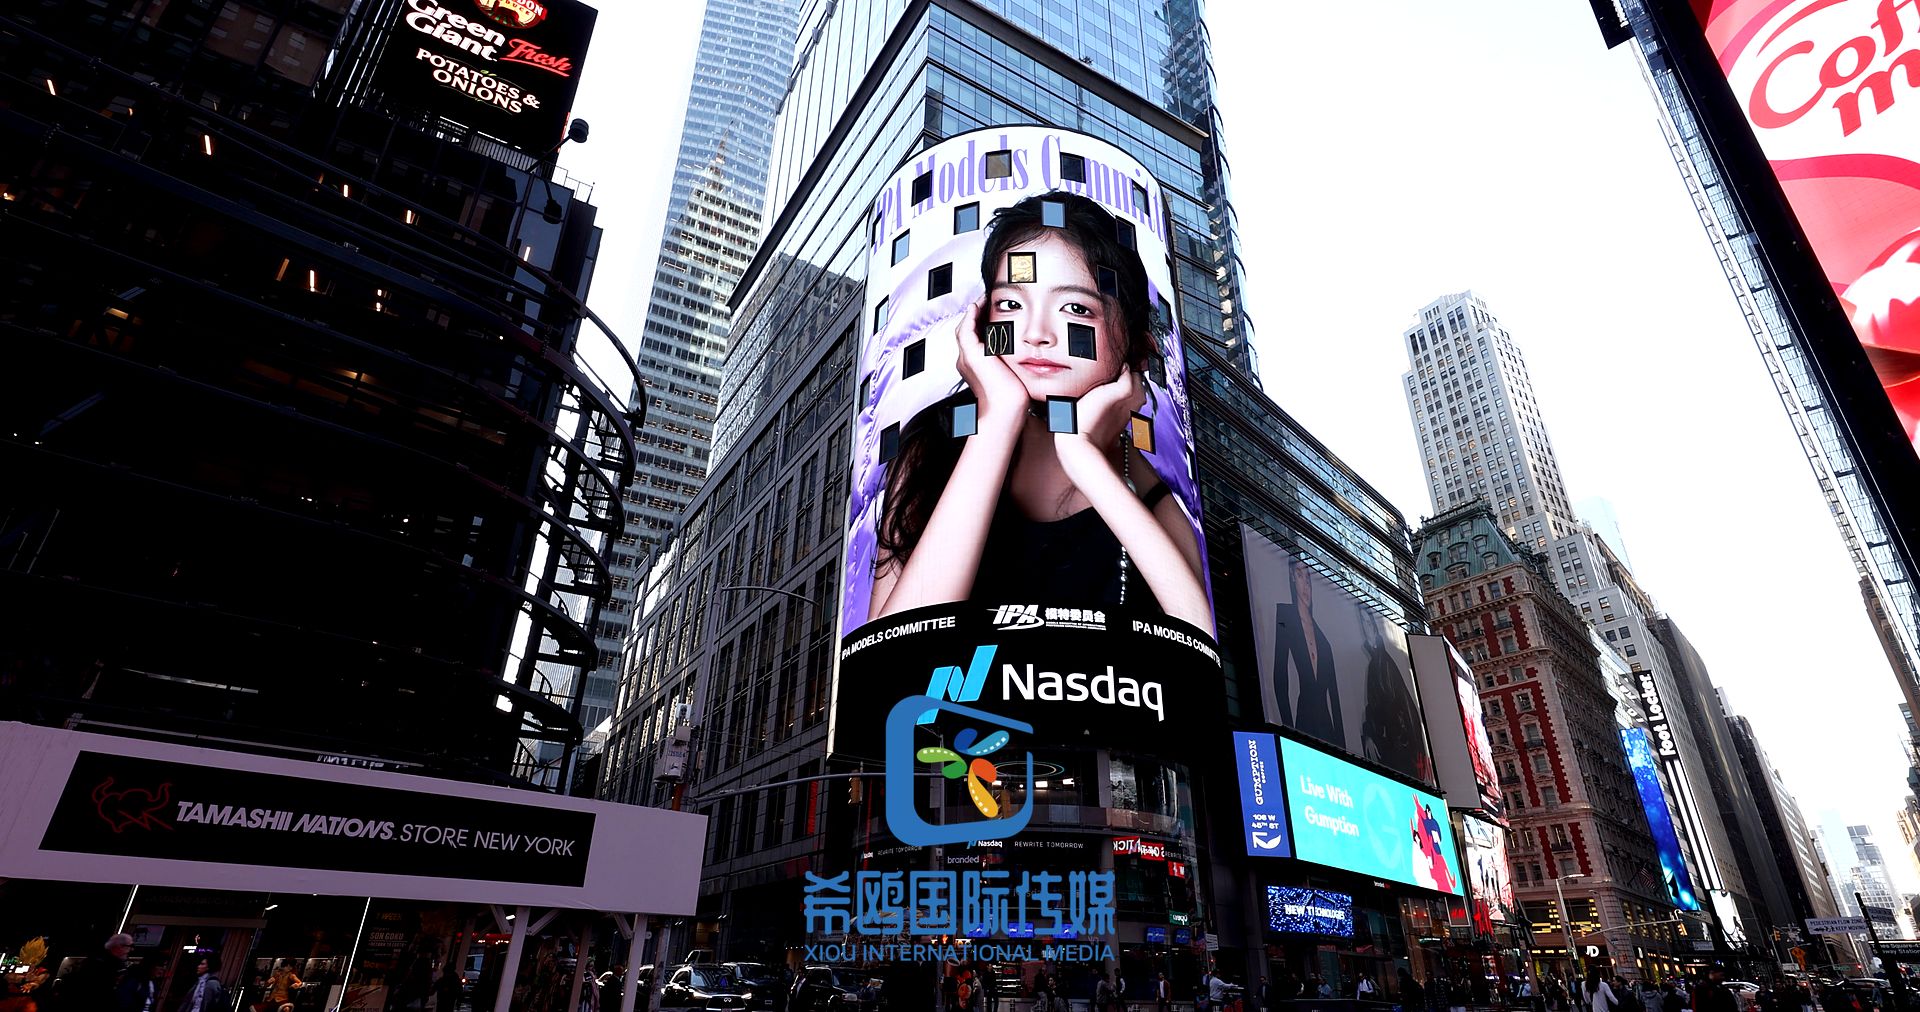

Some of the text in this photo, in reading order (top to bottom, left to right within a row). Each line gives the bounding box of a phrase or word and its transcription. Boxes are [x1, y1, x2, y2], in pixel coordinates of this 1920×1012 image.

[406, 11, 497, 61] Giant
[408, 0, 505, 46] Green
[508, 38, 573, 72] Fresh
[416, 47, 541, 109] POTATOES &
[433, 69, 522, 113] ONIONS
[992, 604, 1040, 625] IPA
[851, 631, 884, 654] MODELS
[884, 616, 956, 640] COMMITTEE
[1132, 620, 1152, 635] IPA
[1153, 625, 1192, 647] MODELS
[1002, 663, 1164, 722] Nasdaq
[1639, 674, 1676, 756] Foot Locker
[1248, 739, 1264, 805] GUMPTION
[1300, 775, 1354, 809] Live With
[176, 801, 575, 856] TAMASHII NATIONS STORE NEW YORK
[1304, 805, 1360, 837] Gumption
[947, 855, 980, 864] branded
[977, 840, 1003, 848] Nasdaq
[1014, 840, 1084, 849] REWRITE TOMORROW
[1284, 904, 1306, 917] NEW
